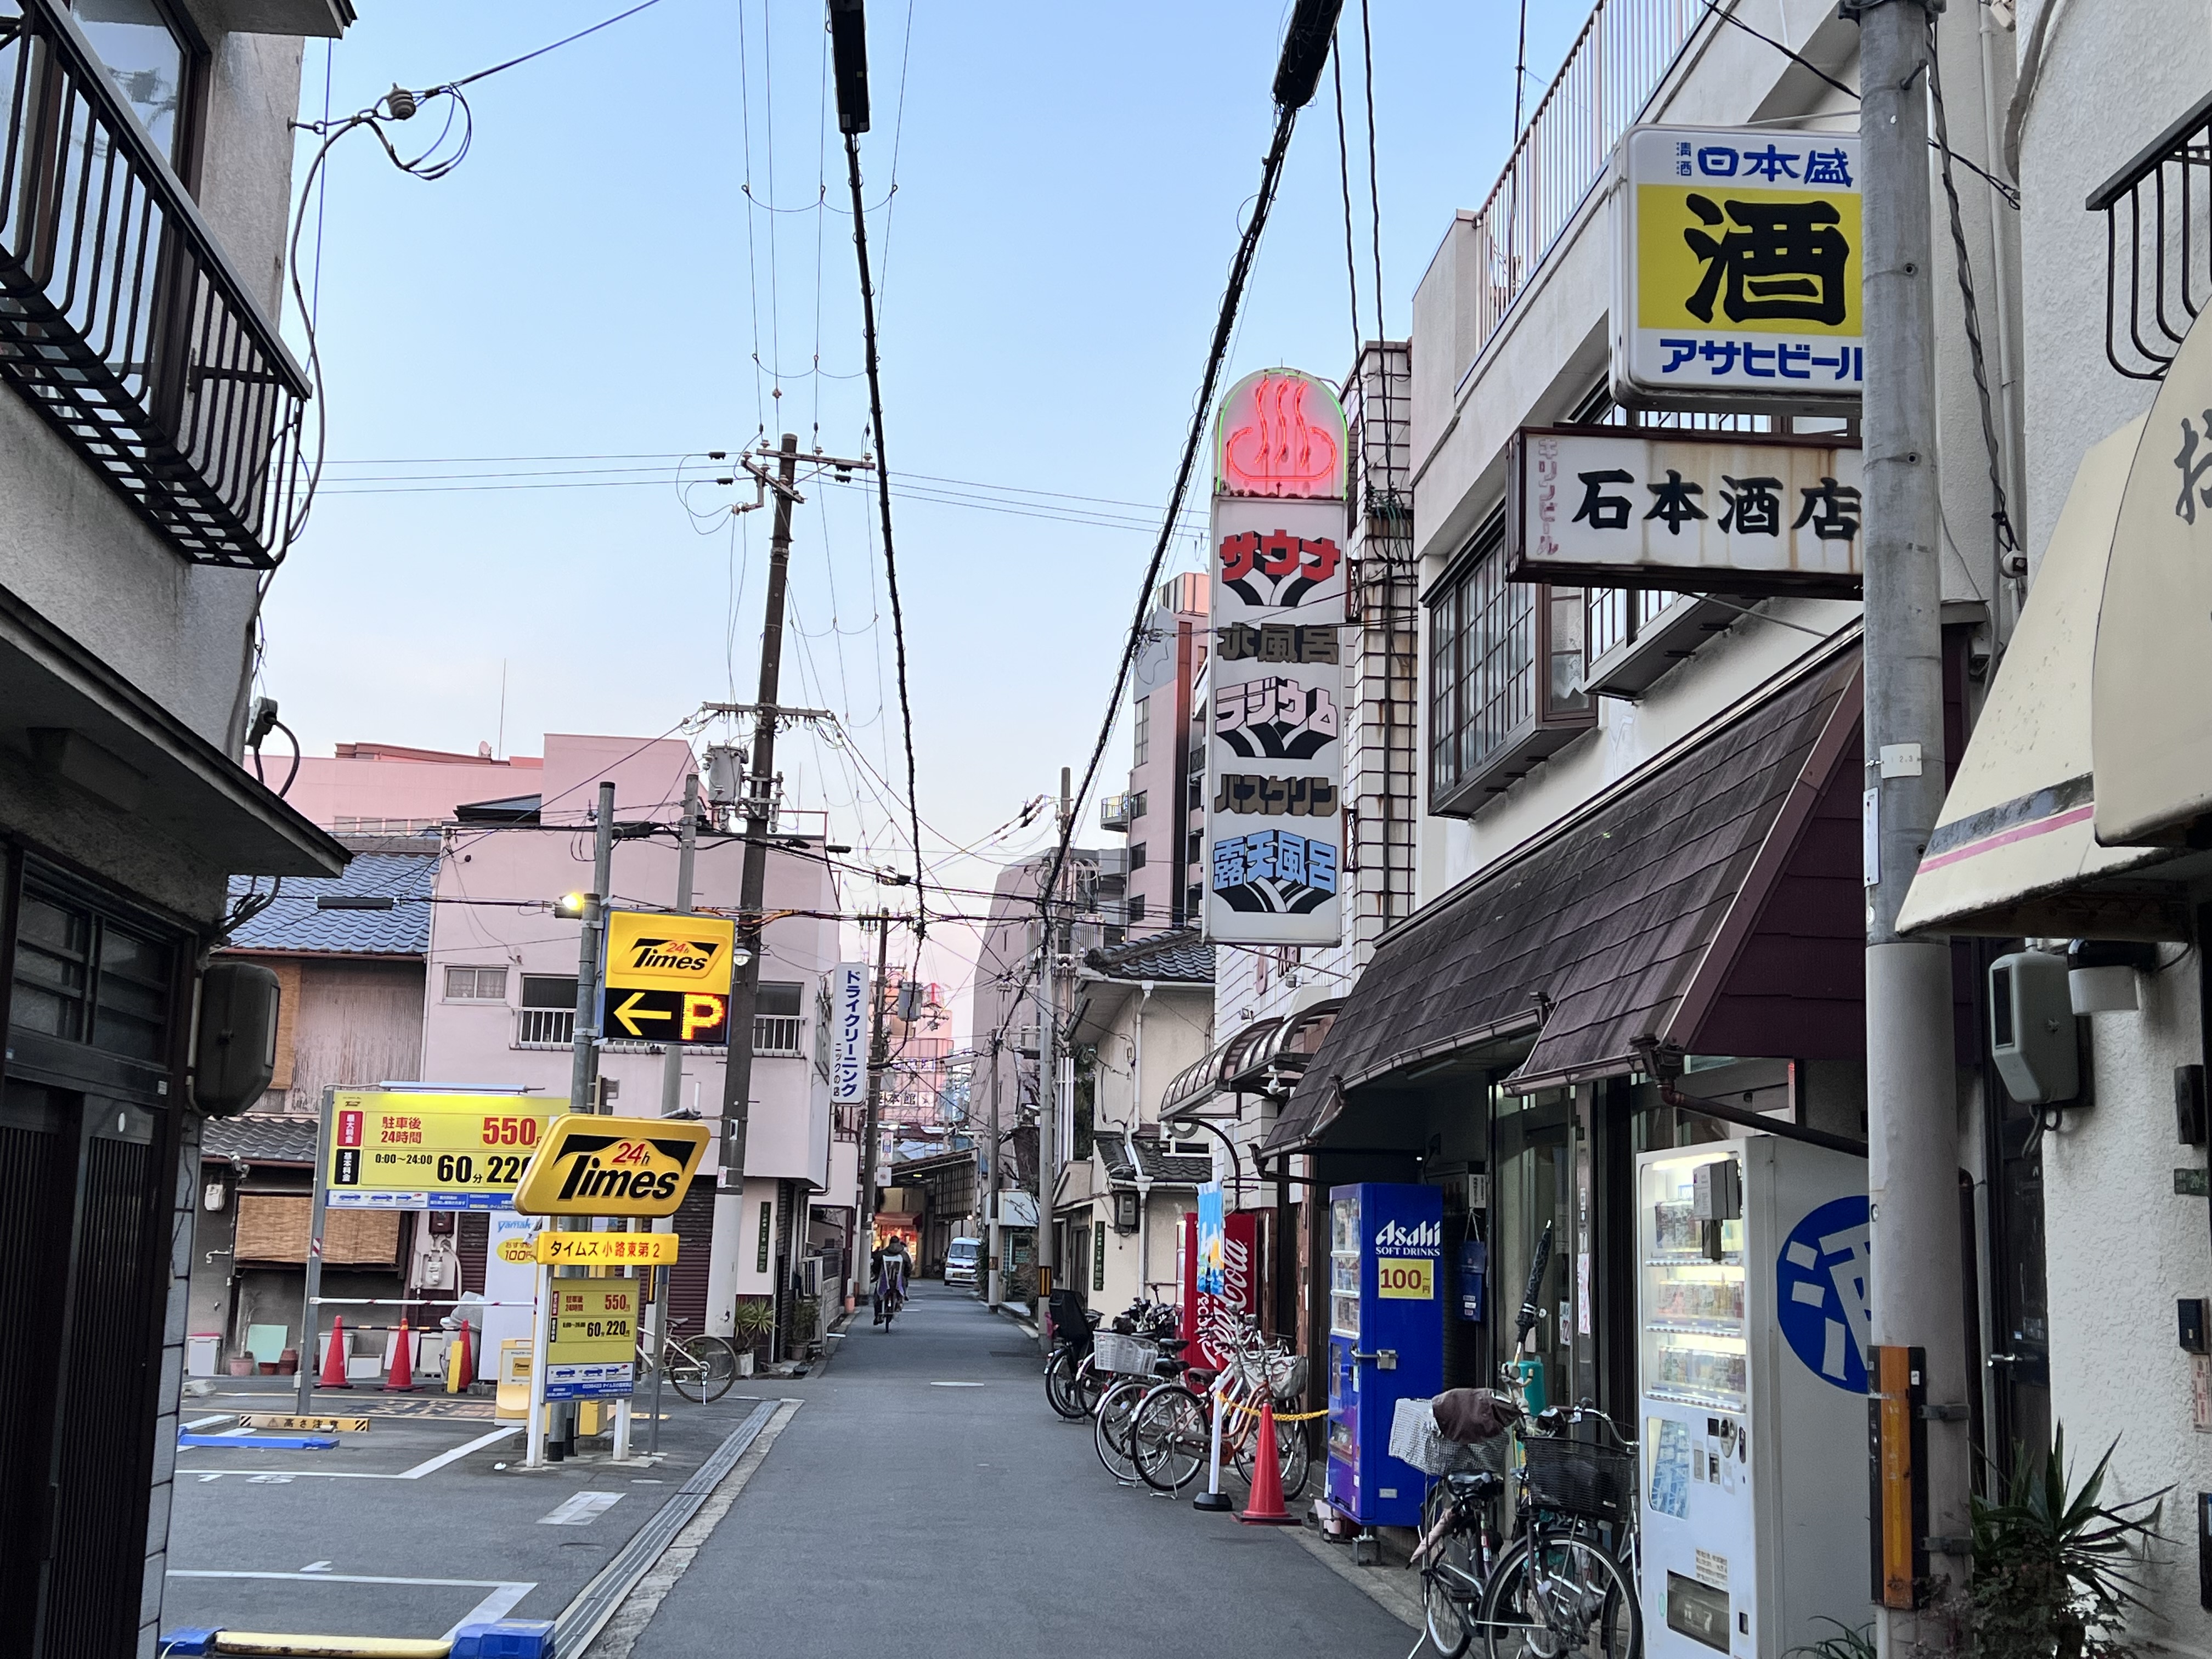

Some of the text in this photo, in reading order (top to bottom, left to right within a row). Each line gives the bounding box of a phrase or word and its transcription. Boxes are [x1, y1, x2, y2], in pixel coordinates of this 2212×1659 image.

[1698, 144, 1854, 188] 日本盛
[1684, 193, 1850, 326] 酒
[1660, 338, 1863, 381] アサヒビール
[1571, 469, 1861, 541] 石本酒店
[1219, 529, 1341, 583] サウナ
[1217, 620, 1339, 665] 水風呂
[1215, 676, 1338, 739] ラジウム
[1214, 774, 1337, 817] バスクリン
[1213, 829, 1336, 895] 露天風呂
[633, 947, 708, 970] Times
[681, 994, 724, 1040] P
[841, 970, 861, 1097] ドライクリーニング
[381, 1116, 421, 1130] 駐車後
[381, 1131, 422, 1144] 24時間
[557, 1154, 680, 1201] Times
[550, 1240, 600, 1257] タイムズ
[1375, 1220, 1440, 1246] Asahi
[1375, 1246, 1440, 1256] SOFT DRINKS
